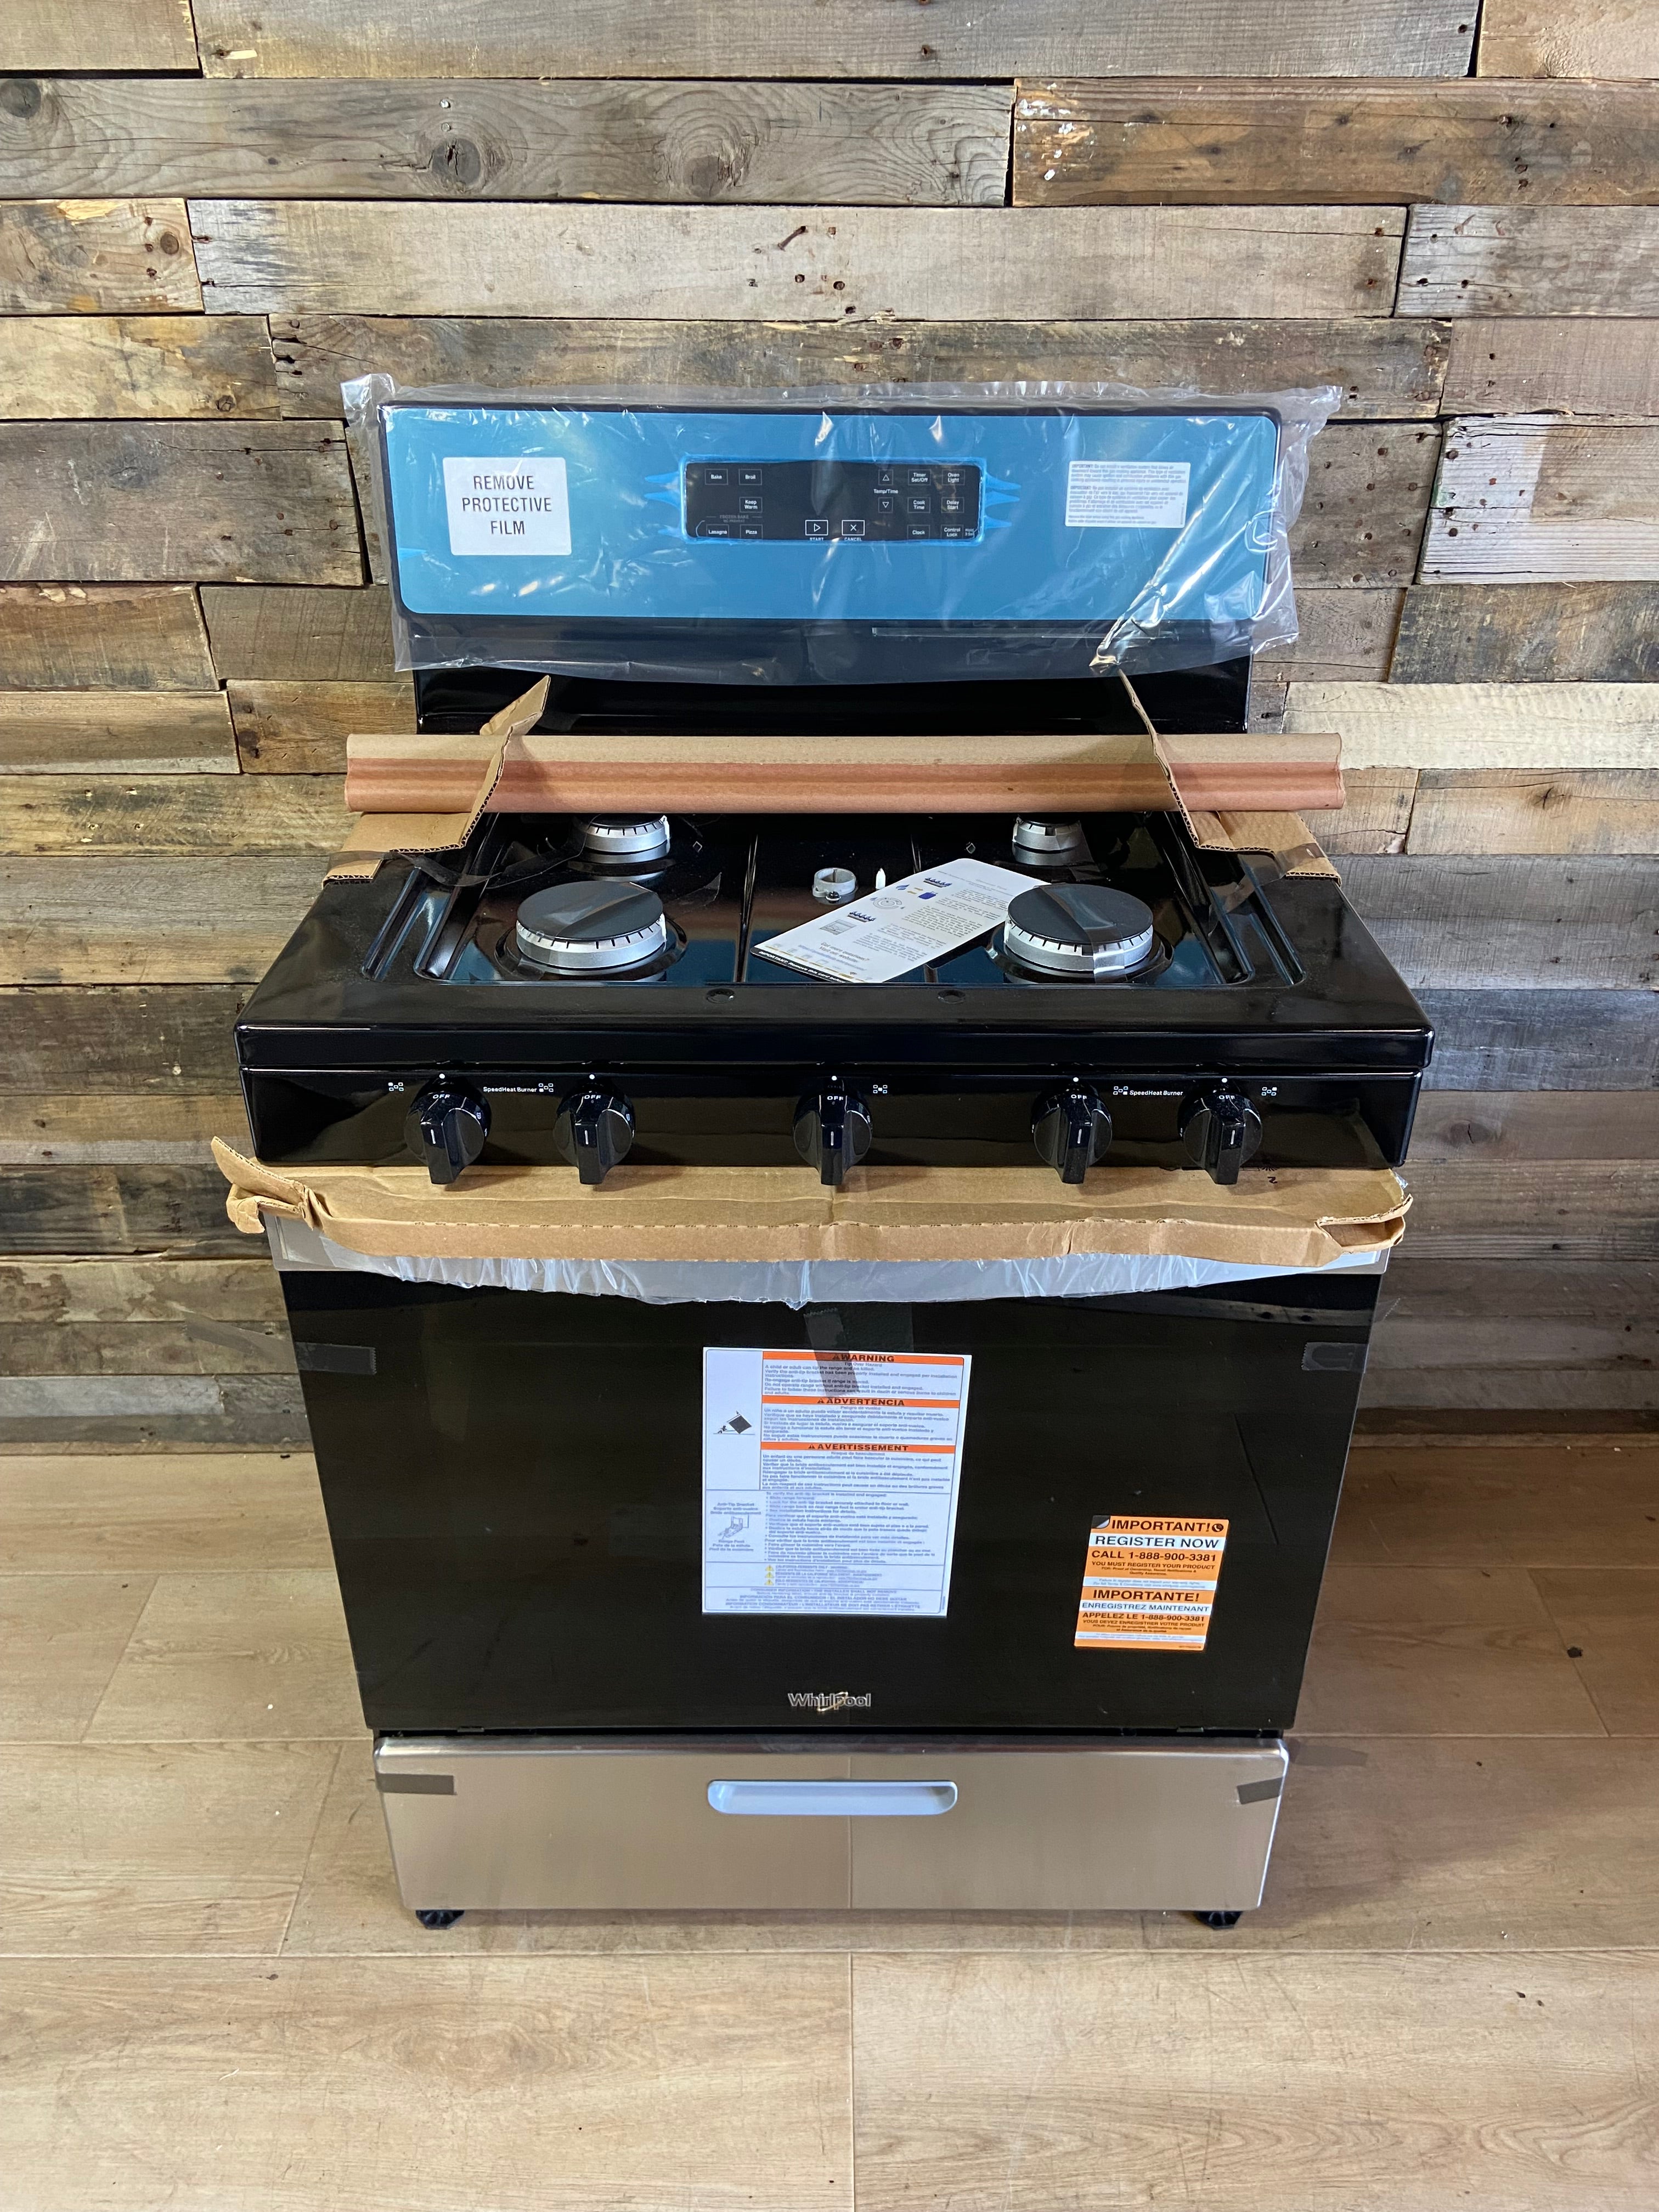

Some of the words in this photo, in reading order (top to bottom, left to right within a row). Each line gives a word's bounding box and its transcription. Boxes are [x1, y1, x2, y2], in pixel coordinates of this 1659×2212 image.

[473, 476, 534, 490] REMOVE
[462, 498, 552, 511] PROTECTIVE
[490, 521, 525, 534] FILM
[1111, 1520, 1210, 1532] IMPORTANT!
[1095, 1536, 1175, 1547] REGISTER
[1181, 1538, 1219, 1548] NOW
[1128, 1551, 1216, 1561] 1-888-900-3381
[1093, 1590, 1199, 1602] IMPORTANTE!
[787, 1692, 871, 1711] Whirlpool
